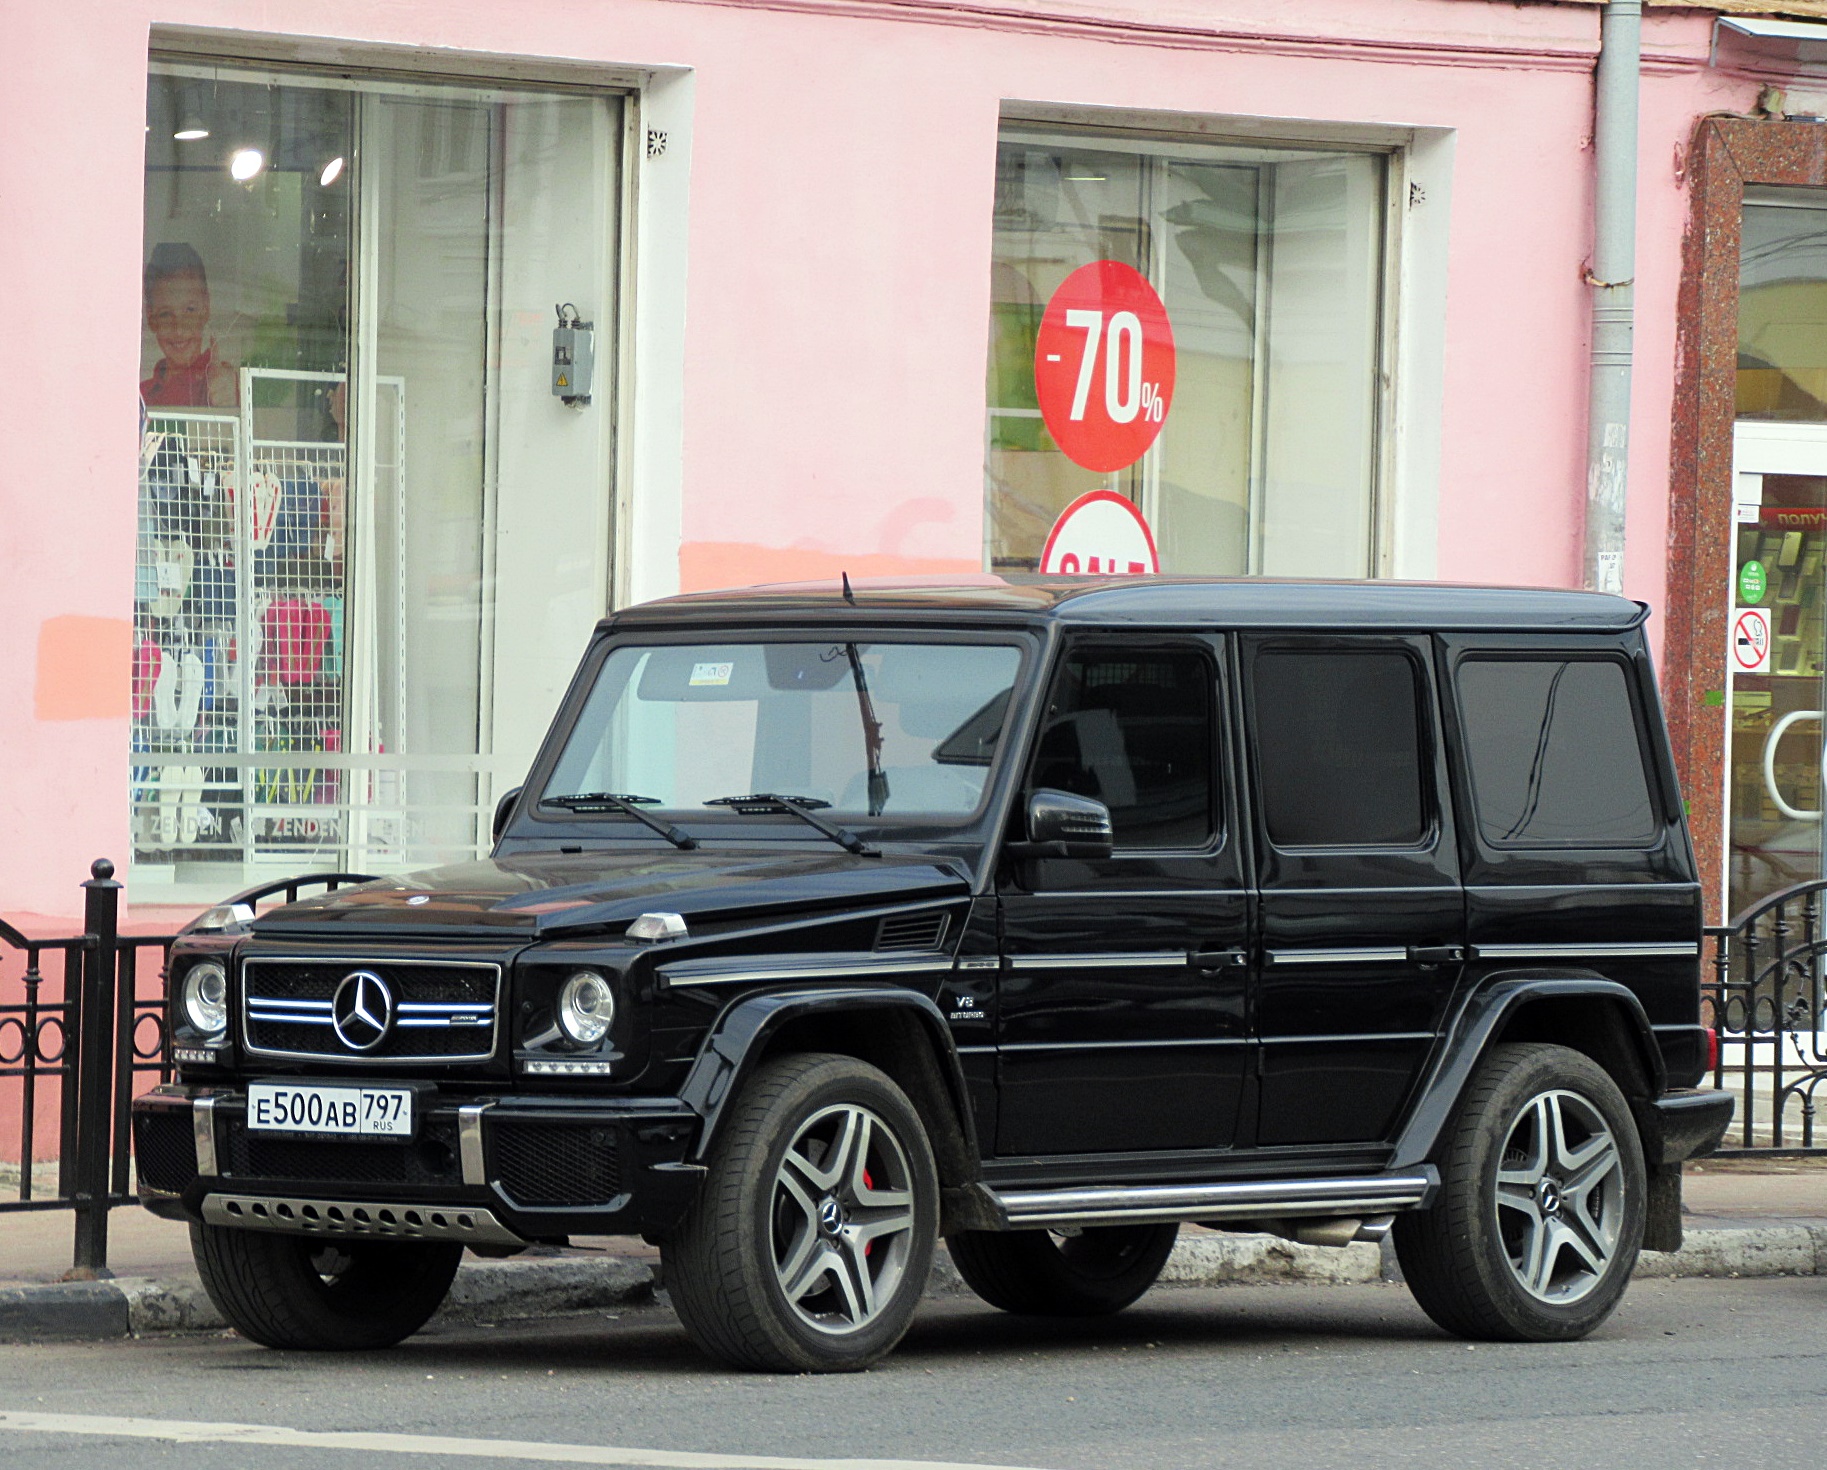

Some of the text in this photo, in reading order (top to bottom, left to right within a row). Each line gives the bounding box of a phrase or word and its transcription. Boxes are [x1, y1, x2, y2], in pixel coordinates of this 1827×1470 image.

[1047, 309, 1162, 424] -70%
[151, 815, 222, 836] ZENDEN
[271, 817, 341, 838] ZENDEN
[363, 1094, 402, 1121] 797
[373, 1121, 393, 1131] RUS
